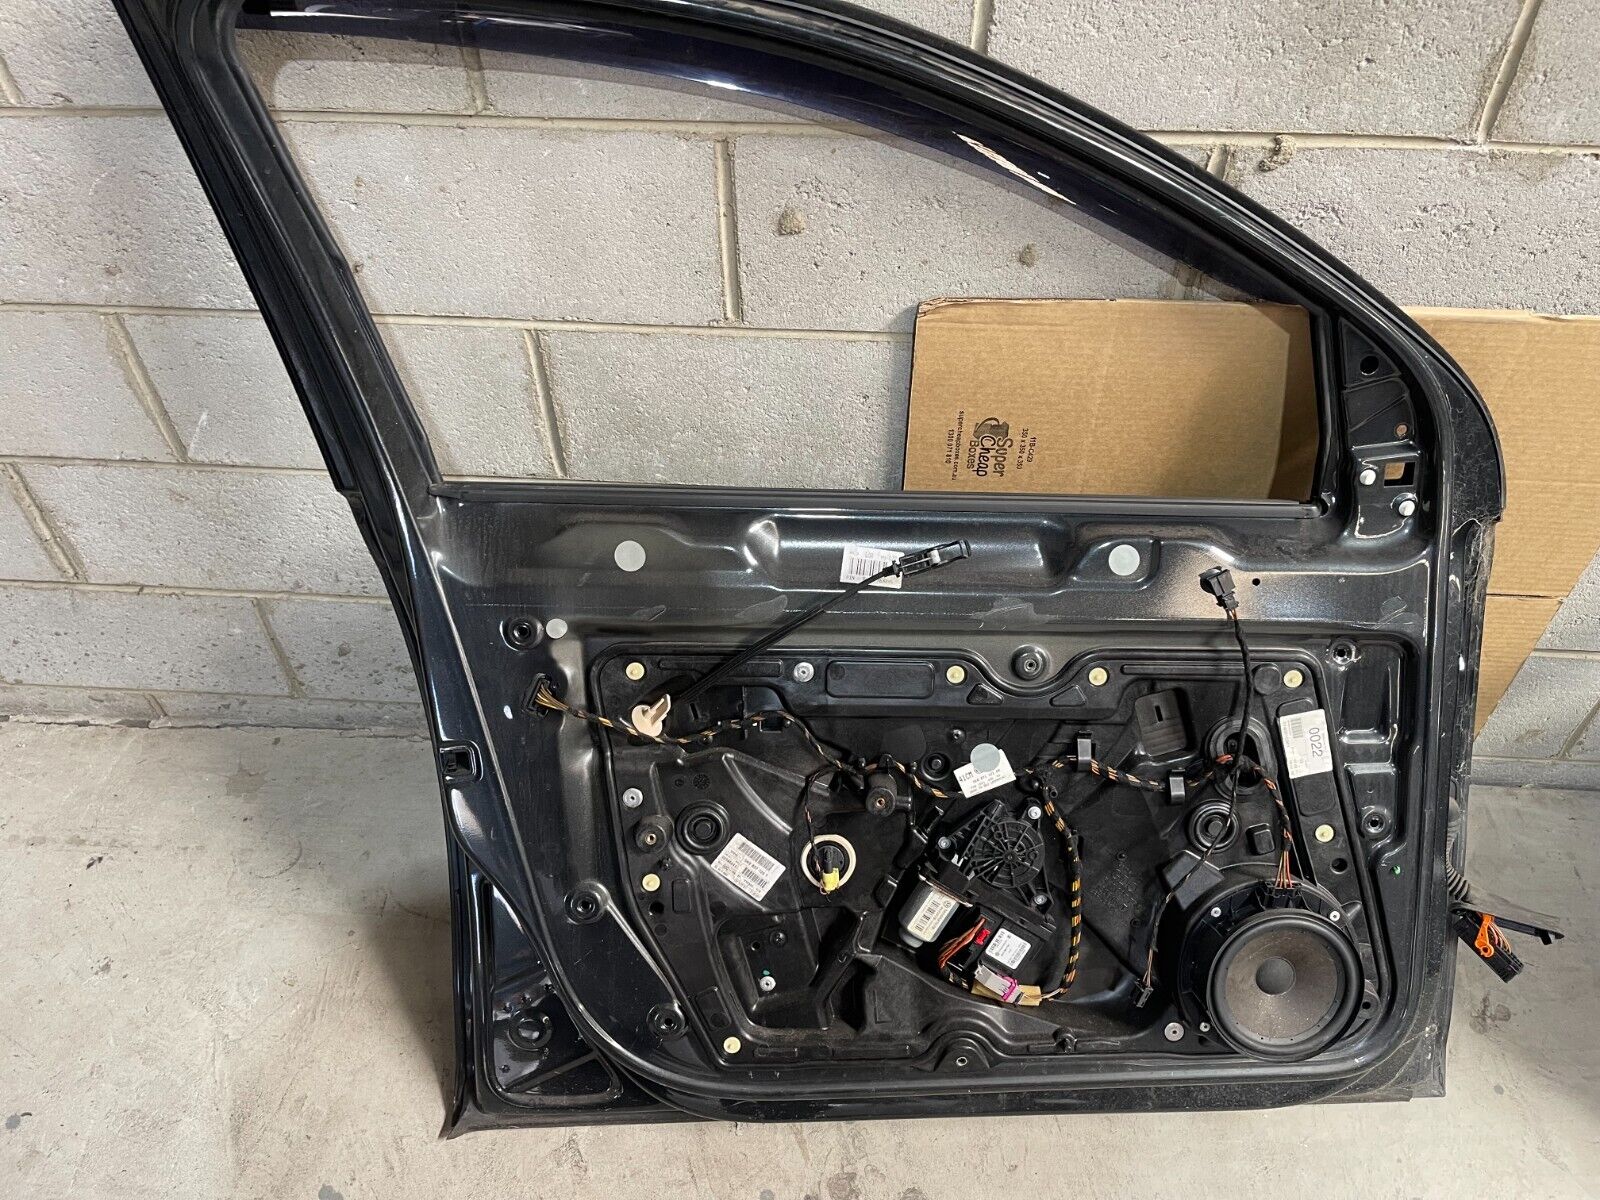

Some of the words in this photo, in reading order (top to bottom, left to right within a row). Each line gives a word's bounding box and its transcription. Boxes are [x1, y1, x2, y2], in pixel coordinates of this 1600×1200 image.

[966, 440, 980, 470] Boxes
[972, 436, 996, 477] Cheap
[991, 438, 1014, 477] Super
[1309, 728, 1323, 758] 0022
